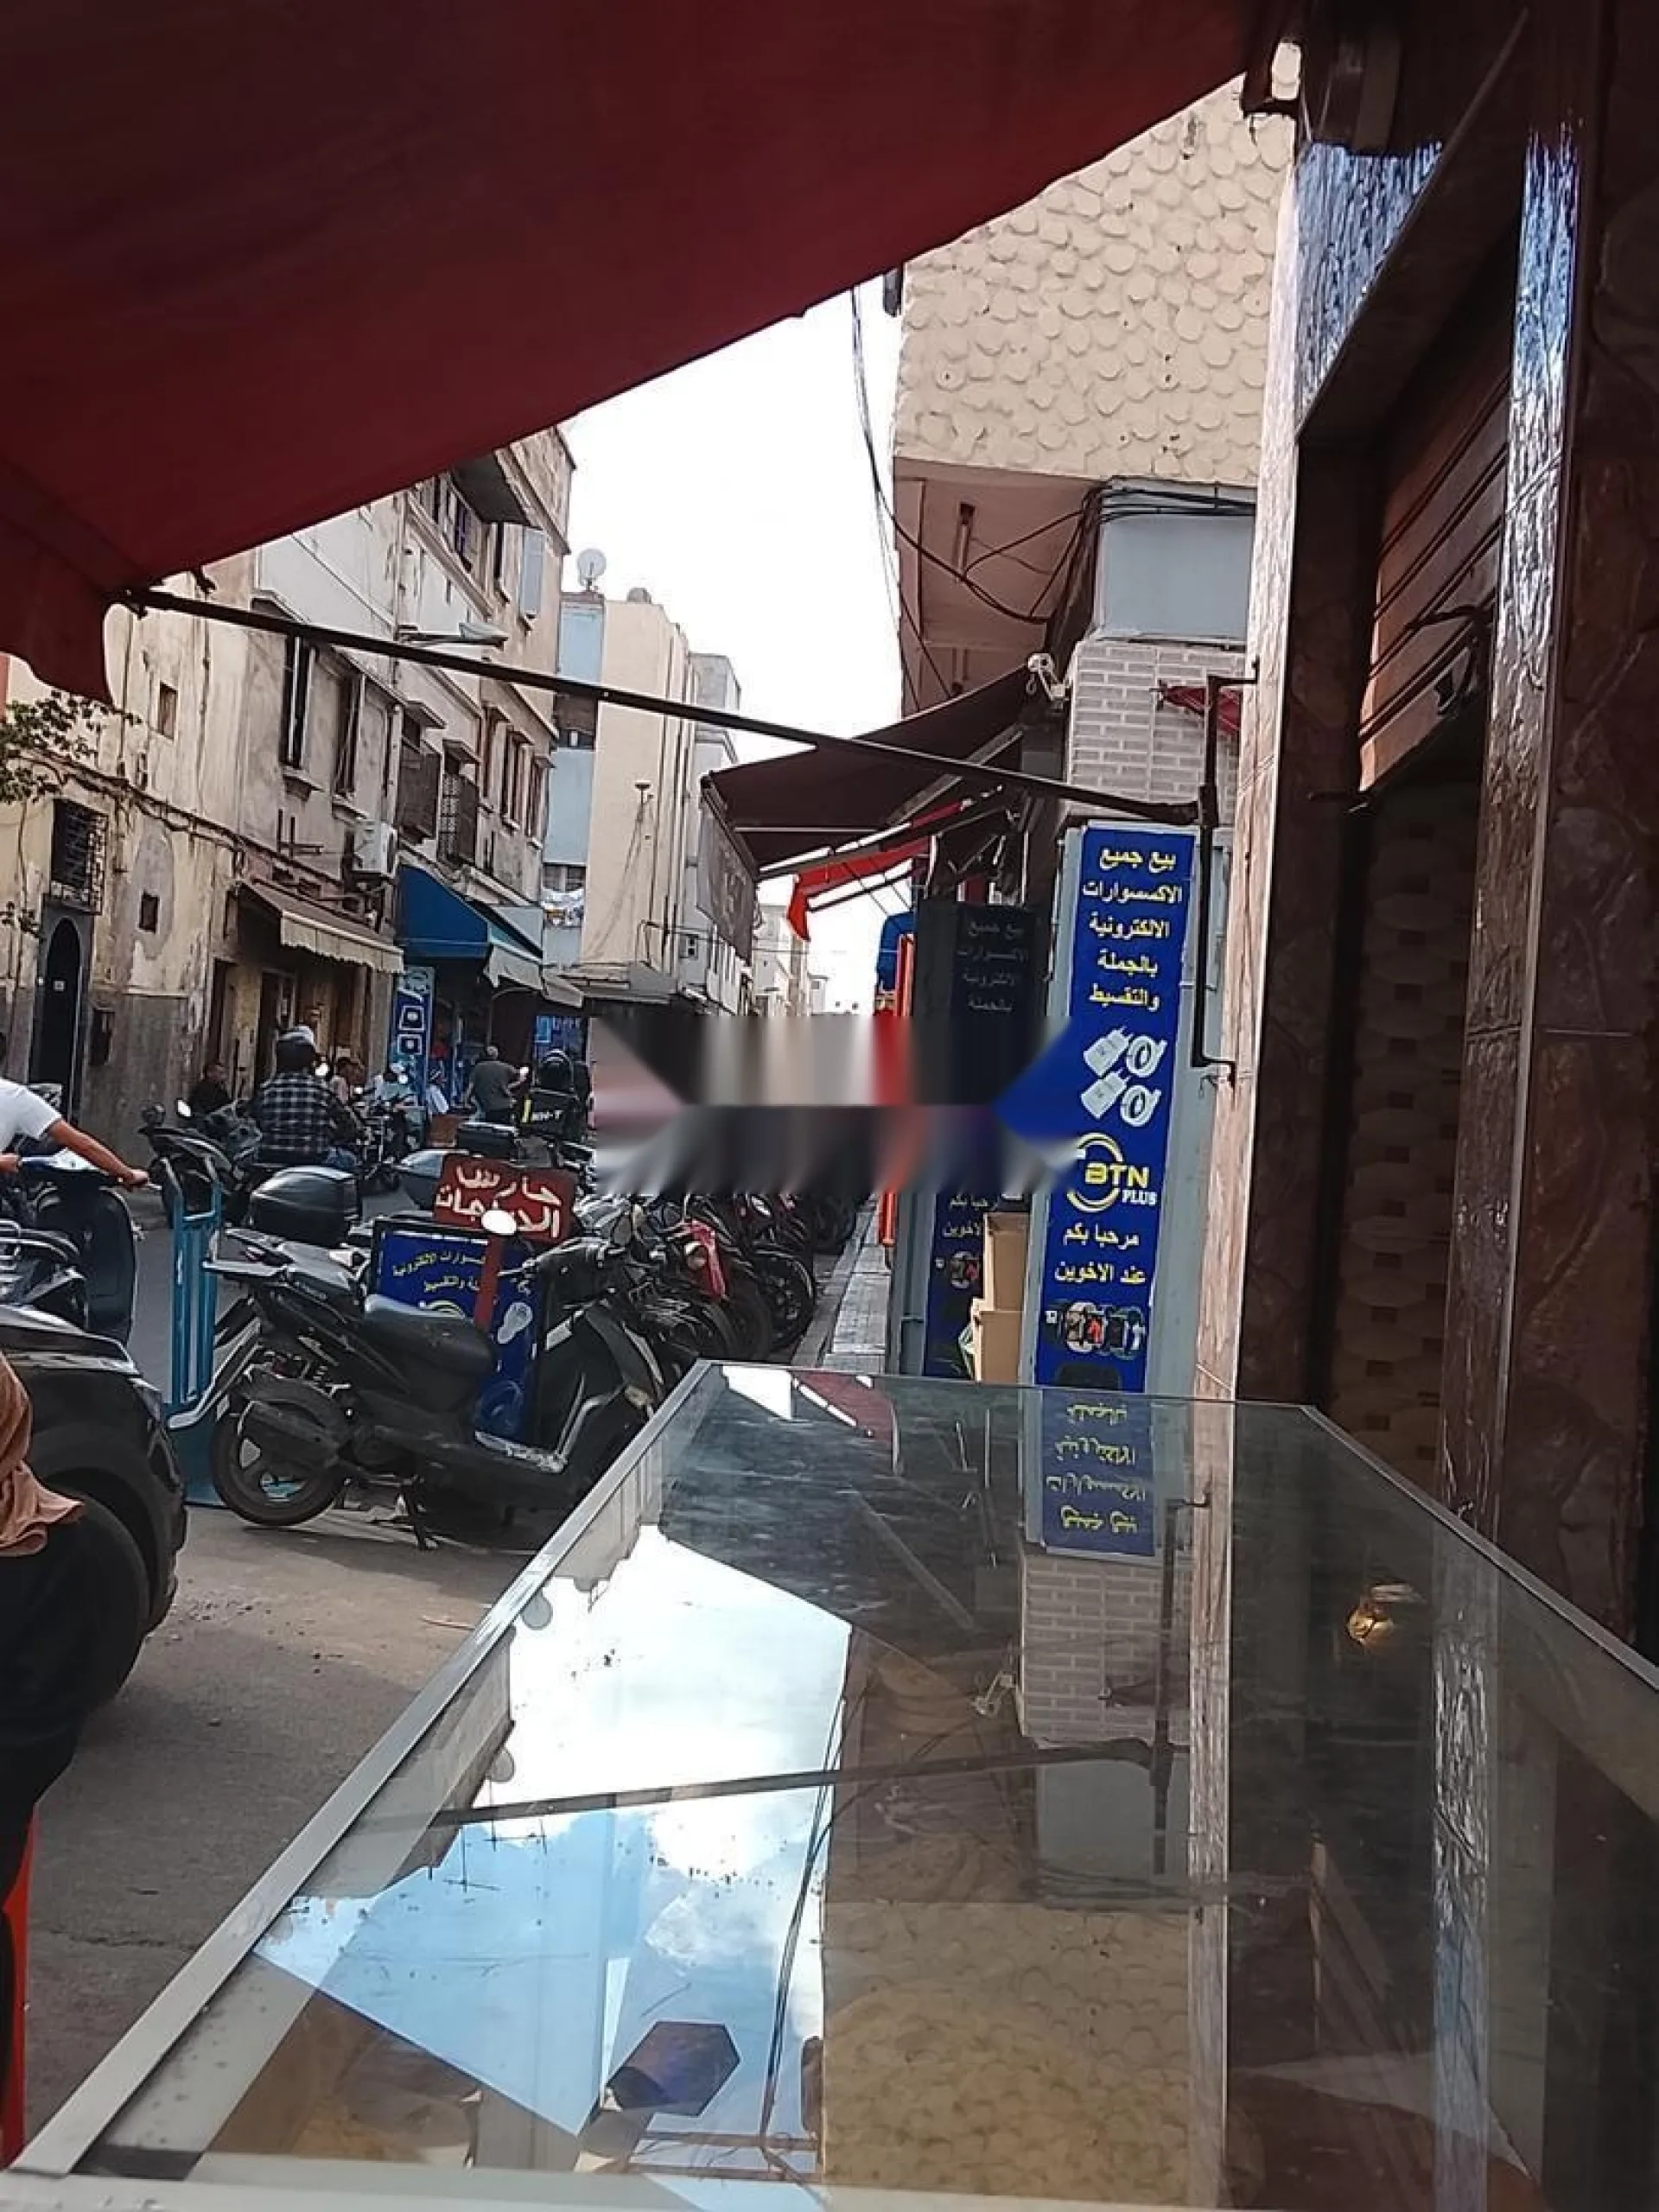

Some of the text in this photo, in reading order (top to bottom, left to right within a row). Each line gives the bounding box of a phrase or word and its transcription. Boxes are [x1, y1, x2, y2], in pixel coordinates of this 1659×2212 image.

[1099, 848, 1176, 874] بيع جميع
[1096, 948, 1159, 977] بالجملة
[1088, 982, 1160, 1012] والتقسيط
[1084, 1162, 1150, 1188] BTN
[1122, 1189, 1158, 1205] PLUS
[435, 1185, 560, 1238] الدجات
[1062, 1222, 1140, 1249] مرحبا بكم
[1054, 1261, 1146, 1284] عند الاخوين
